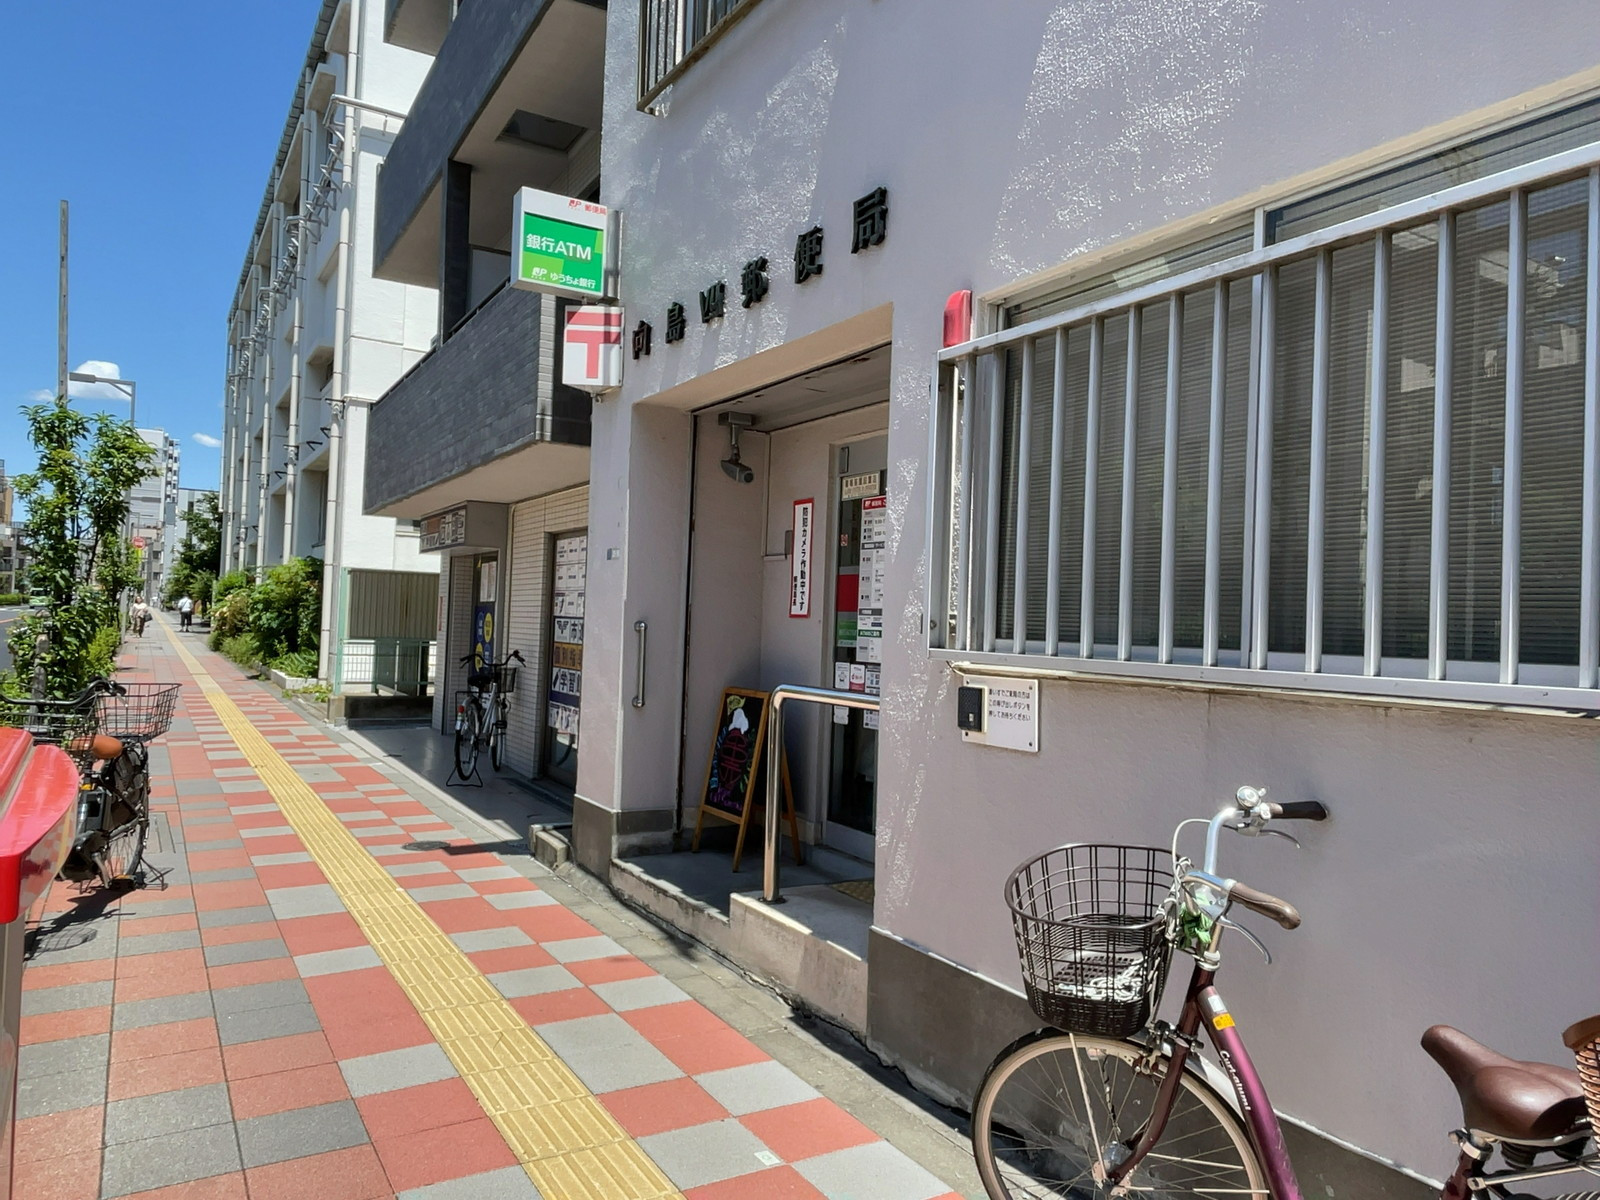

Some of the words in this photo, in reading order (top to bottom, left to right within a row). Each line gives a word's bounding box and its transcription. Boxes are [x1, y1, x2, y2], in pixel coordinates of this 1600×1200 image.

[584, 204, 607, 216] 郵便局
[526, 233, 592, 261] 銀行ATM
[632, 186, 889, 360] 向島四郵便局
[550, 273, 596, 289] ゆうちょ銀行
[989, 699, 1030, 711] この呼び出しボタンを
[989, 710, 1031, 721] 押してお待ちください
